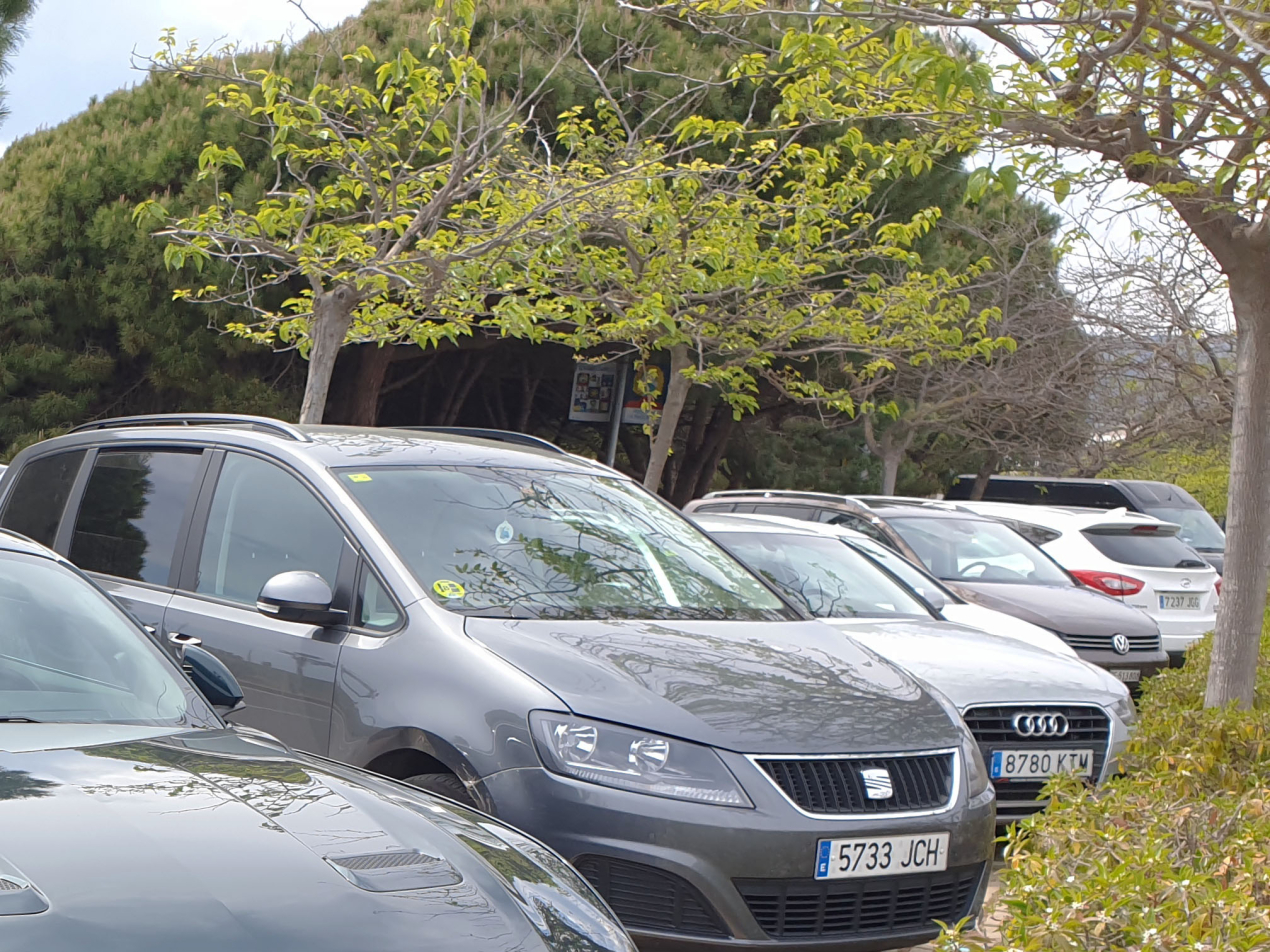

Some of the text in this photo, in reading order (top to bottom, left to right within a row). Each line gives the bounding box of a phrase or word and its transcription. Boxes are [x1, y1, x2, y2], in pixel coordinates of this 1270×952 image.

[1005, 754, 1051, 774] 8780
[838, 842, 892, 872] 5733
[901, 838, 939, 867] JCH
